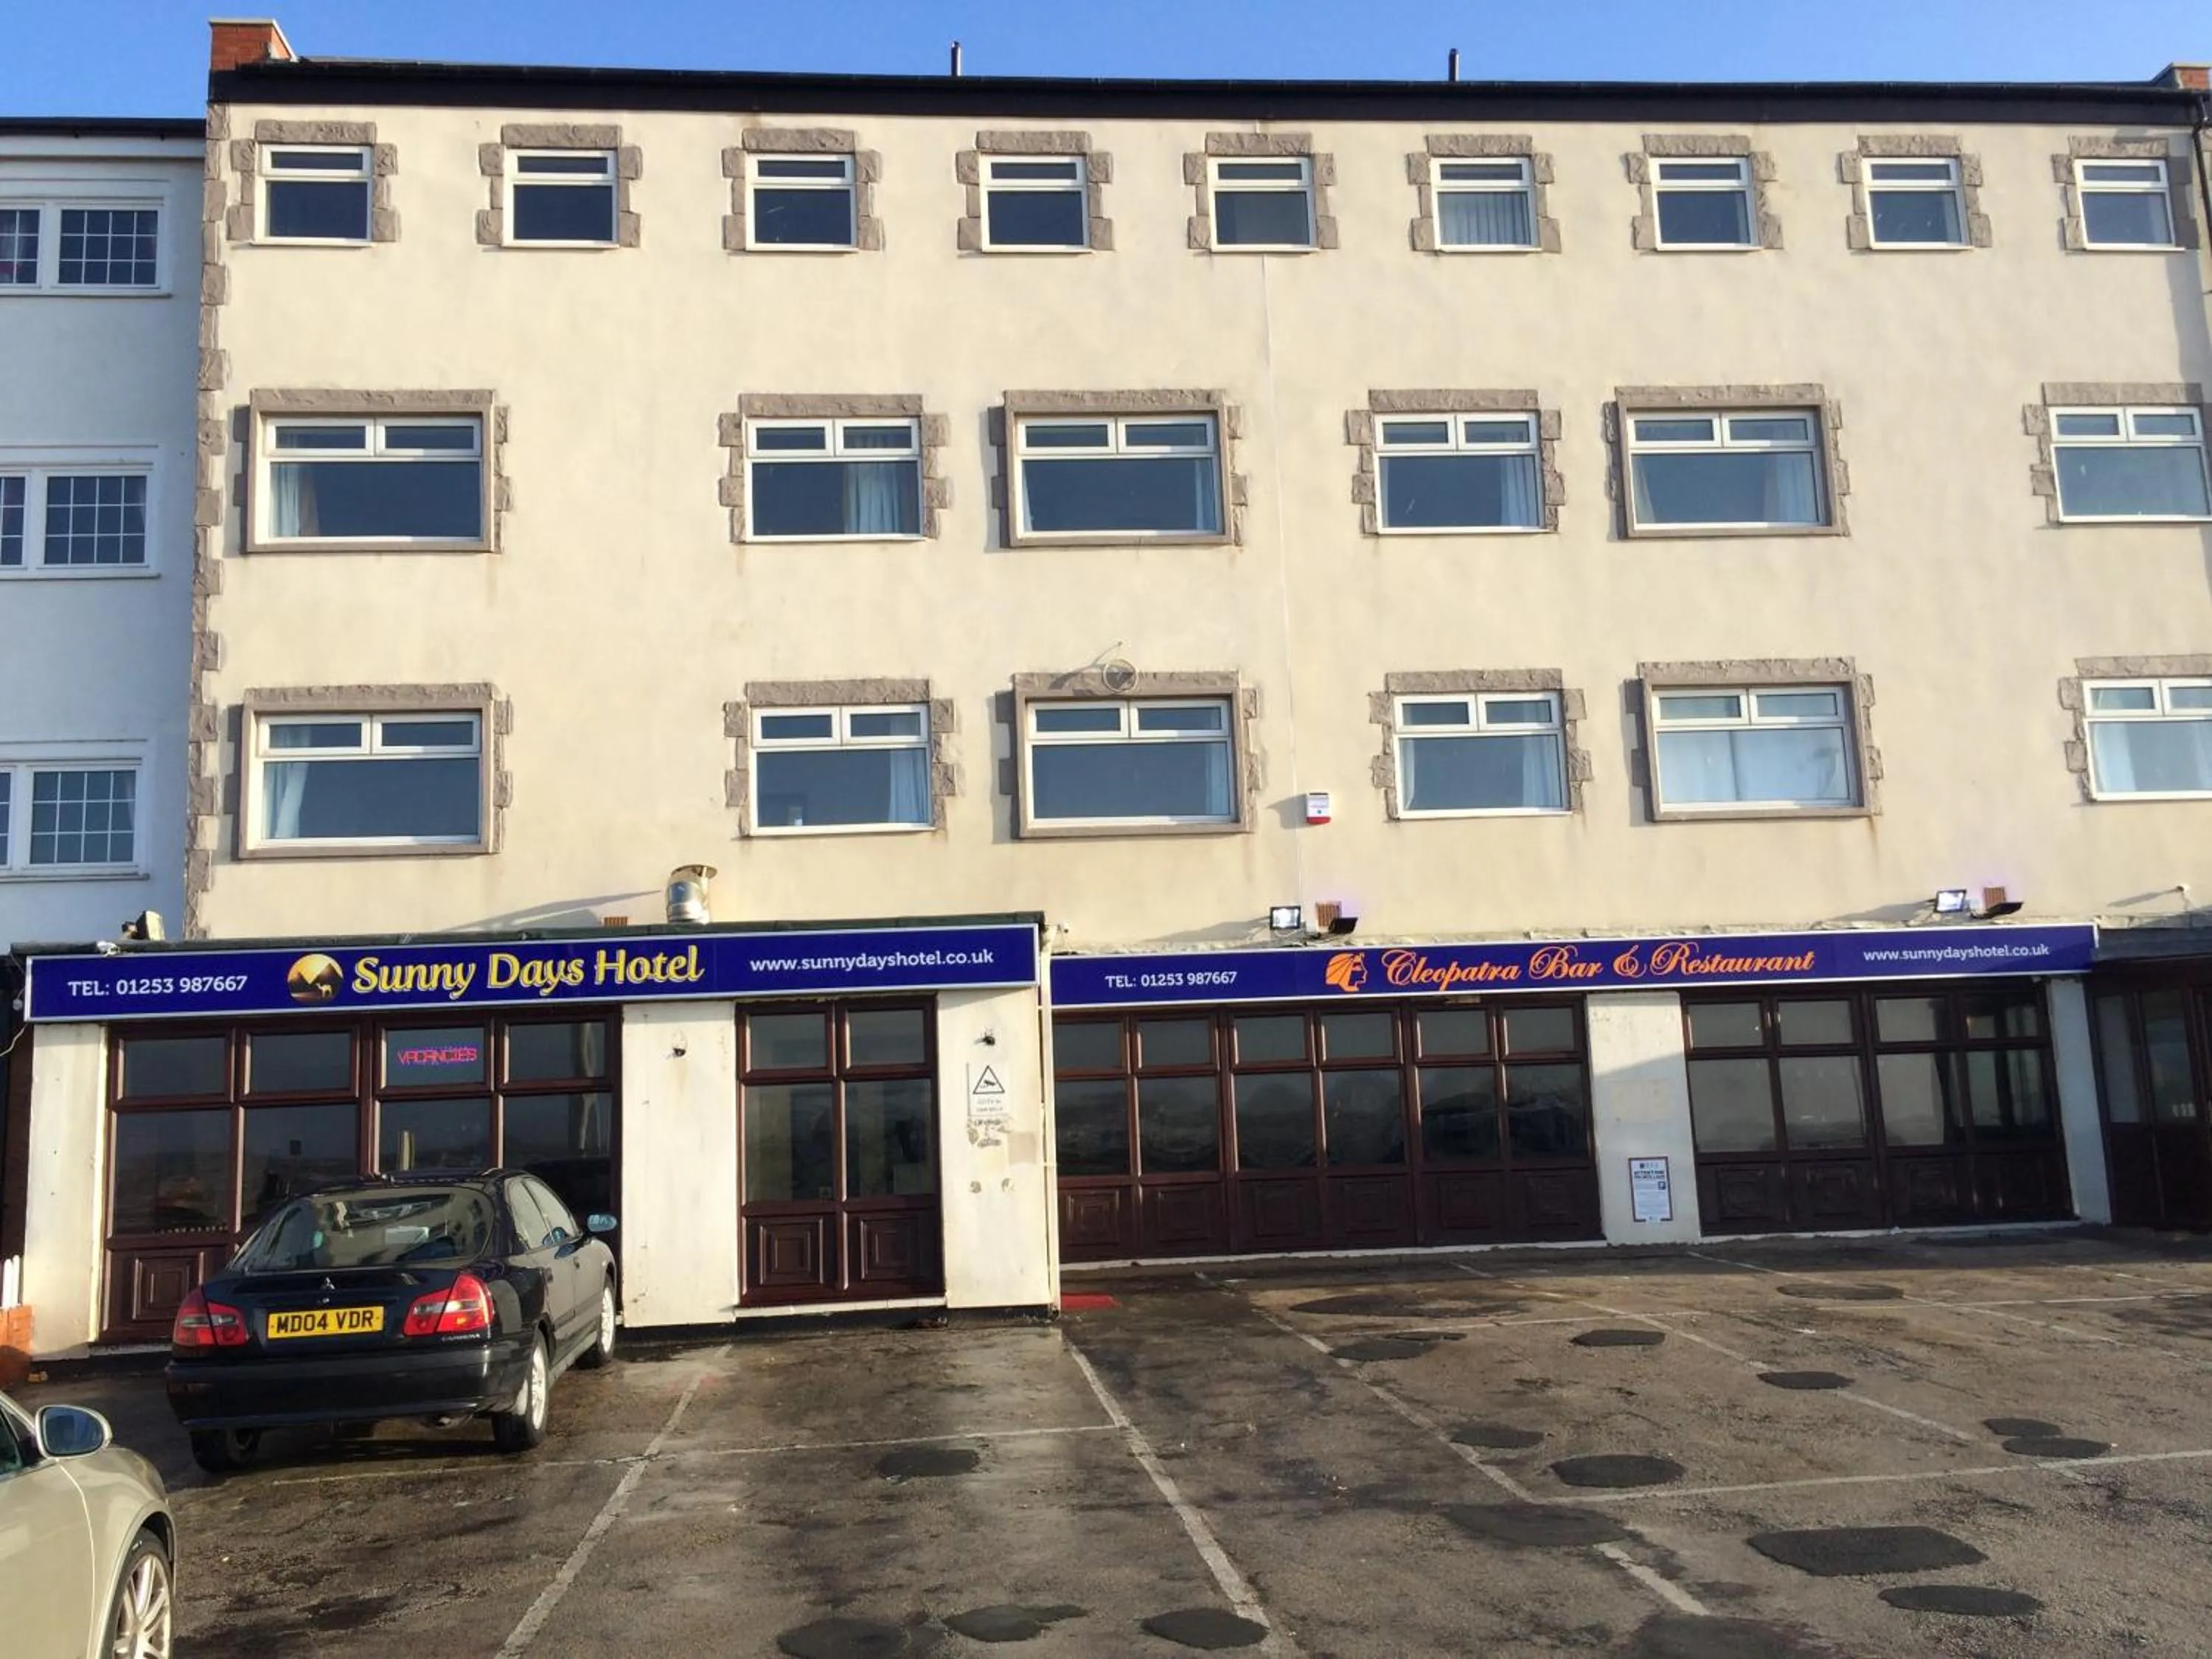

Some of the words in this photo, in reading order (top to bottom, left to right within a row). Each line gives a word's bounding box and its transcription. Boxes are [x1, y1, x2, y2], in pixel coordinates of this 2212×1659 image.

[750, 948, 994, 972] www.sunnydayshotel.co.uk
[1863, 944, 2050, 963] www.sunnydayshotel.co.uk
[352, 956, 476, 1000] Sunny
[487, 952, 585, 997] Days
[594, 945, 706, 985] Hotel
[1381, 947, 1521, 991] Cleopatra
[1528, 945, 1603, 979] Bar
[1612, 944, 1647, 978] &
[1649, 942, 1815, 975] Restaurant
[67, 980, 110, 996] TEL:
[116, 978, 174, 995] 01253
[179, 975, 248, 993] 987667
[1105, 975, 1136, 988] TEL:
[1141, 973, 1183, 987] 01253
[1186, 971, 1238, 986] 987667
[397, 1047, 478, 1064] VACANCIES
[276, 1313, 328, 1334] MD04
[335, 1310, 374, 1329] VDR
